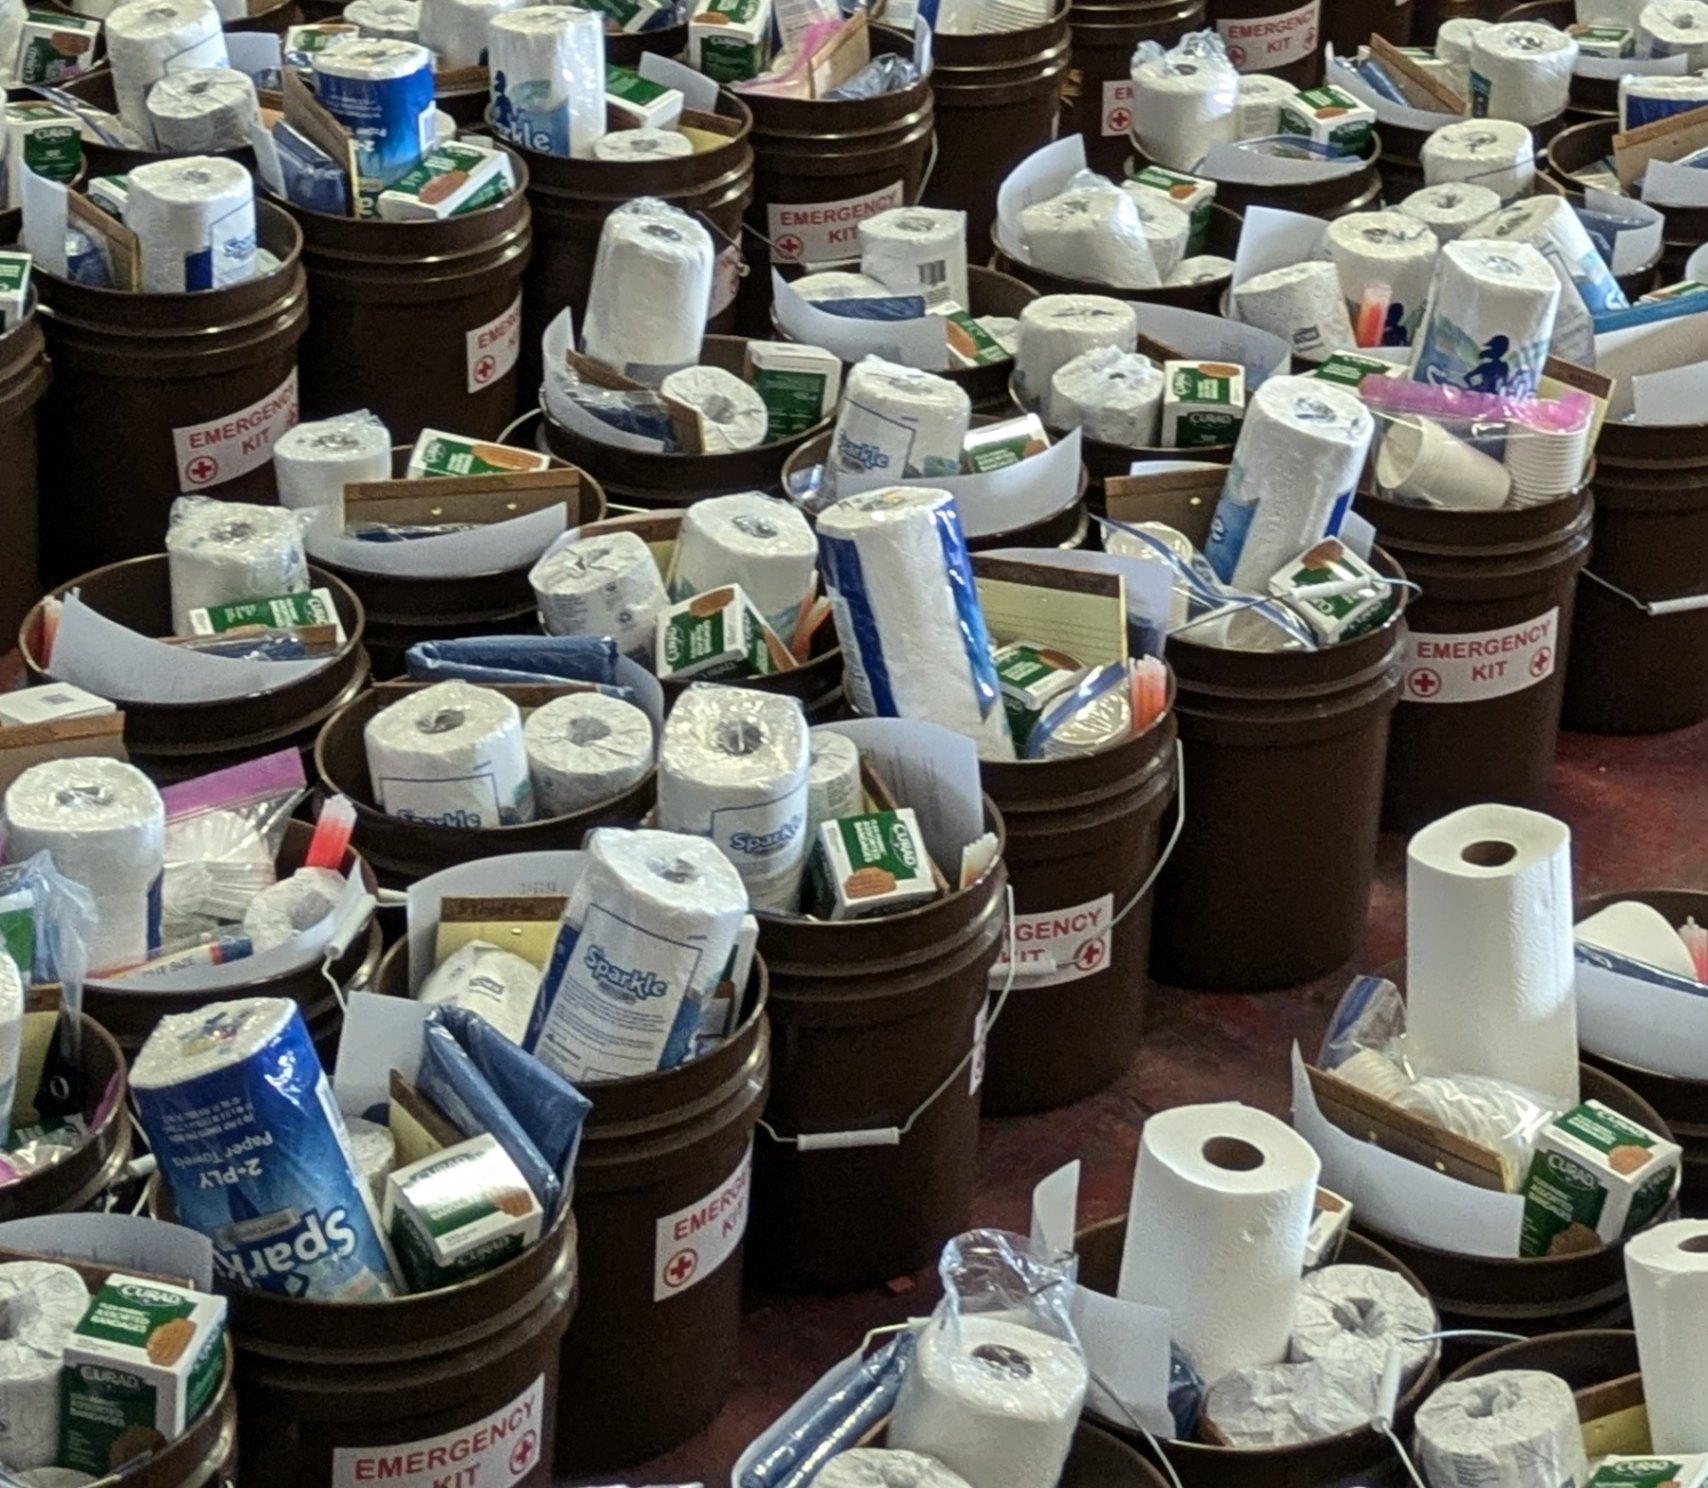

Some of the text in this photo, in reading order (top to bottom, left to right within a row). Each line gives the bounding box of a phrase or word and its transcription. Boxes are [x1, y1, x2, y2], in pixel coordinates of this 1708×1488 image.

[1267, 38, 1290, 54] KIT
[781, 196, 898, 226] EMERGENCY
[829, 226, 860, 244] KIT
[1190, 413, 1232, 425] CURAD
[242, 431, 271, 455] KIT
[1417, 622, 1550, 659] EMERGENCY
[1472, 662, 1507, 681] KIT
[892, 821, 918, 869] CURAD
[1015, 908, 1103, 942] GENCY
[585, 944, 668, 1000] Sparkle
[224, 1130, 274, 1158] Paper
[1550, 1153, 1596, 1188] CURAD
[213, 1209, 356, 1288] Spark
[120, 1284, 182, 1306] CURAD
[79, 1365, 140, 1389] CURAD
[355, 1397, 539, 1482] EMERGENCY
[1613, 1460, 1670, 1475] CURAD
